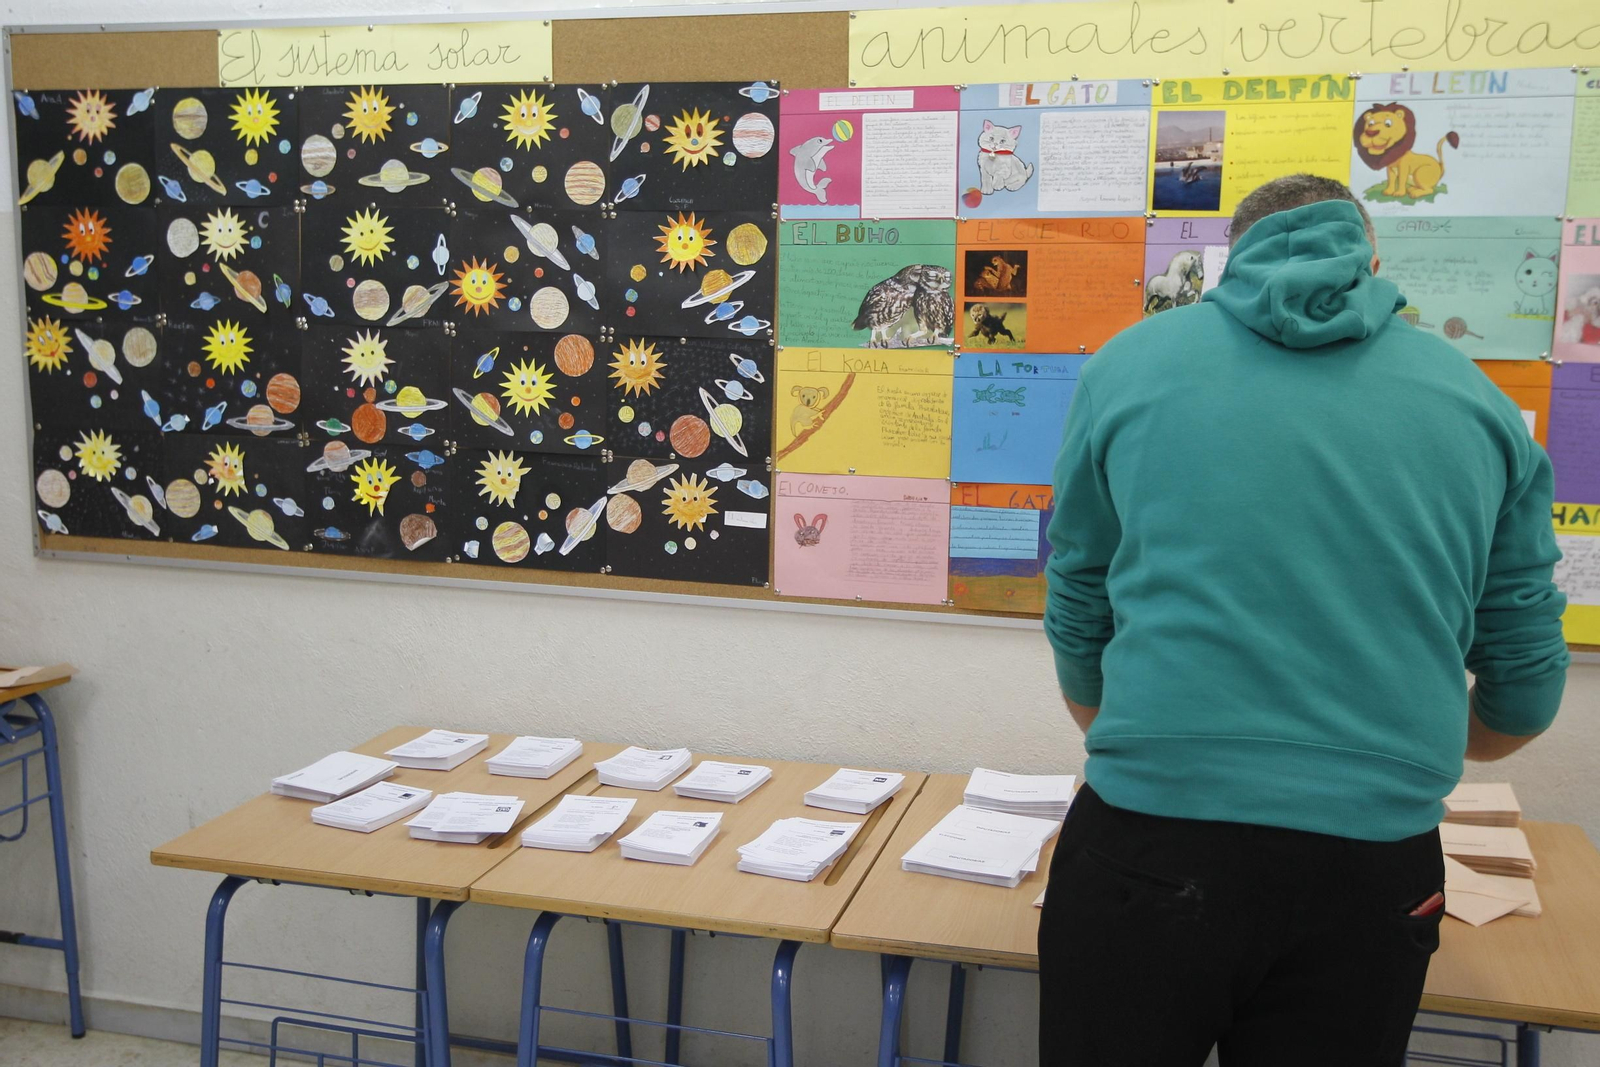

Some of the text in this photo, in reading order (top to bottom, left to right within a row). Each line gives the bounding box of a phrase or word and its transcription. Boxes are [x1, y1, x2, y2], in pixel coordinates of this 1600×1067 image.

[861, 1, 1208, 69] animales
[220, 28, 521, 85] El sistema solar
[1008, 83, 1110, 107] EL GATO
[1162, 80, 1202, 104] EL
[1389, 73, 1422, 95] EL
[826, 96, 842, 107] EL
[791, 222, 827, 245] EL
[976, 221, 1000, 242] EL
[1180, 221, 1199, 239] EL
[843, 353, 889, 373] KOALA
[978, 359, 1003, 377] LA
[962, 485, 992, 507] EL
